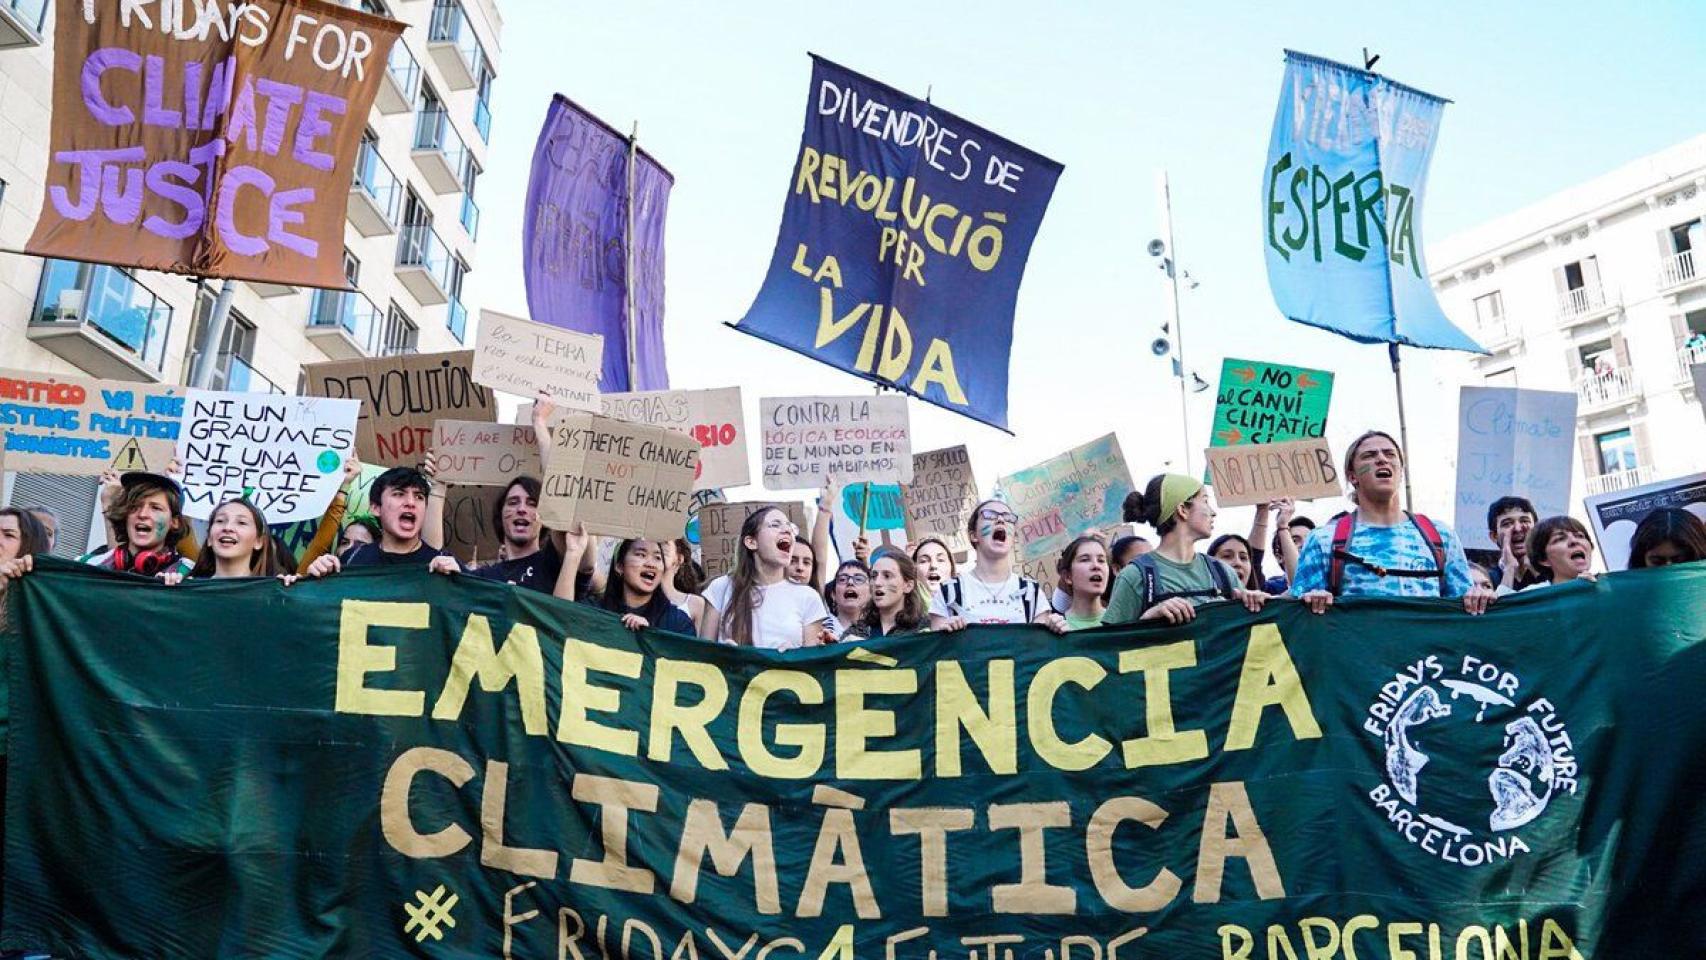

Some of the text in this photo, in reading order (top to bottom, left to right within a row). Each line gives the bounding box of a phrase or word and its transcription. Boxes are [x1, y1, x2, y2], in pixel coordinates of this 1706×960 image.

[284, 14, 372, 82] FOR
[80, 47, 347, 171] CLIMATE
[818, 80, 1024, 193] DIVENDRES DE
[796, 147, 1008, 272] REVOLUCIÓ
[791, 243, 843, 288] LA
[879, 227, 926, 287] PER
[531, 332, 586, 364] TERRA
[815, 287, 969, 406] VIDA
[1261, 367, 1292, 388] NO
[101, 390, 134, 411] VA
[546, 383, 595, 404] MATANT
[1217, 389, 1235, 405] al
[0, 403, 79, 431] STRAS
[195, 400, 287, 422] NI UN
[601, 395, 689, 424] RACIAS
[773, 401, 870, 426] CONTRA LA
[1467, 398, 1562, 438] Climate
[190, 419, 353, 449] GRAU MÉS
[376, 426, 431, 460] NOT
[440, 426, 466, 446] WE
[474, 429, 499, 445] ARE
[558, 426, 699, 470] SYSTHEME CHANGE
[690, 422, 737, 447] BIO
[186, 442, 301, 470] NI UNA
[437, 454, 484, 471] OUT
[499, 453, 527, 473] OF
[765, 441, 895, 460] DEL MUNDO EN
[912, 456, 928, 473] HY
[182, 462, 321, 492] ESPECIE
[606, 463, 637, 479] NOT
[765, 462, 781, 476] EL
[787, 462, 820, 475] QUE
[925, 471, 942, 485] GO
[943, 468, 962, 483] TO
[1210, 457, 1245, 497] NO
[1314, 448, 1338, 484] B
[183, 487, 300, 514] MEYS
[545, 474, 687, 513] CLIMATE CHANGE
[711, 508, 730, 536] DE
[1021, 512, 1064, 543] PUTA
[334, 598, 1323, 780] EMERGÈNCIA
[1363, 654, 1579, 796] FRIDAYS FOR FUTURE
[380, 746, 1286, 919] CLIMÀTICA
[1368, 783, 1531, 867] BARCELONA
